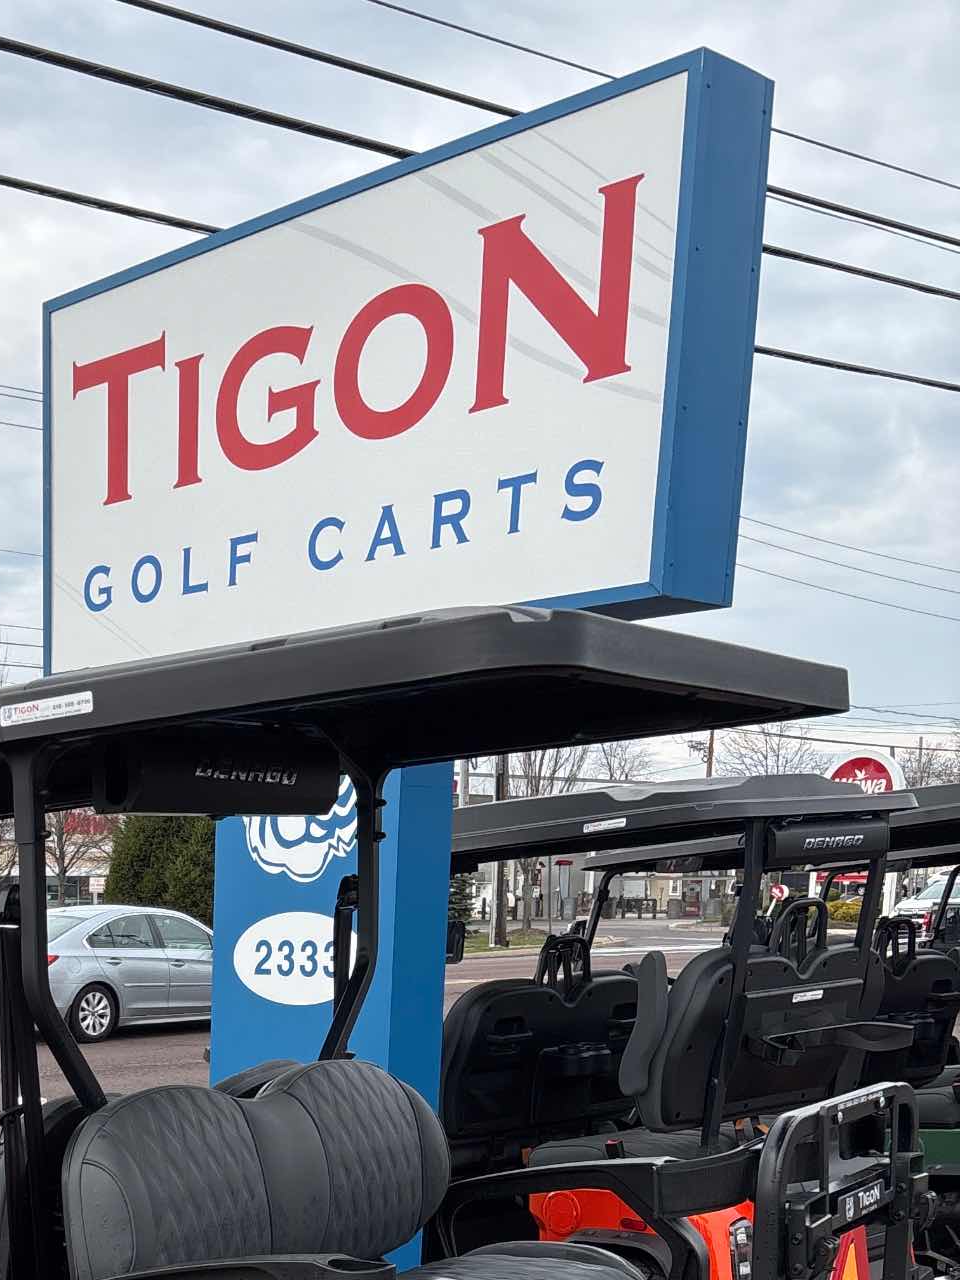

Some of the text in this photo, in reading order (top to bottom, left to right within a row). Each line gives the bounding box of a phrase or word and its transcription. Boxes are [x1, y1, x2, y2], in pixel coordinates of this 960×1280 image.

[73, 173, 644, 506] TIGON
[84, 459, 604, 612] GOLF CARTS
[14, 703, 40, 716] TIGON
[803, 834, 864, 850] DENAGO
[858, 1183, 880, 1209] TIGON
